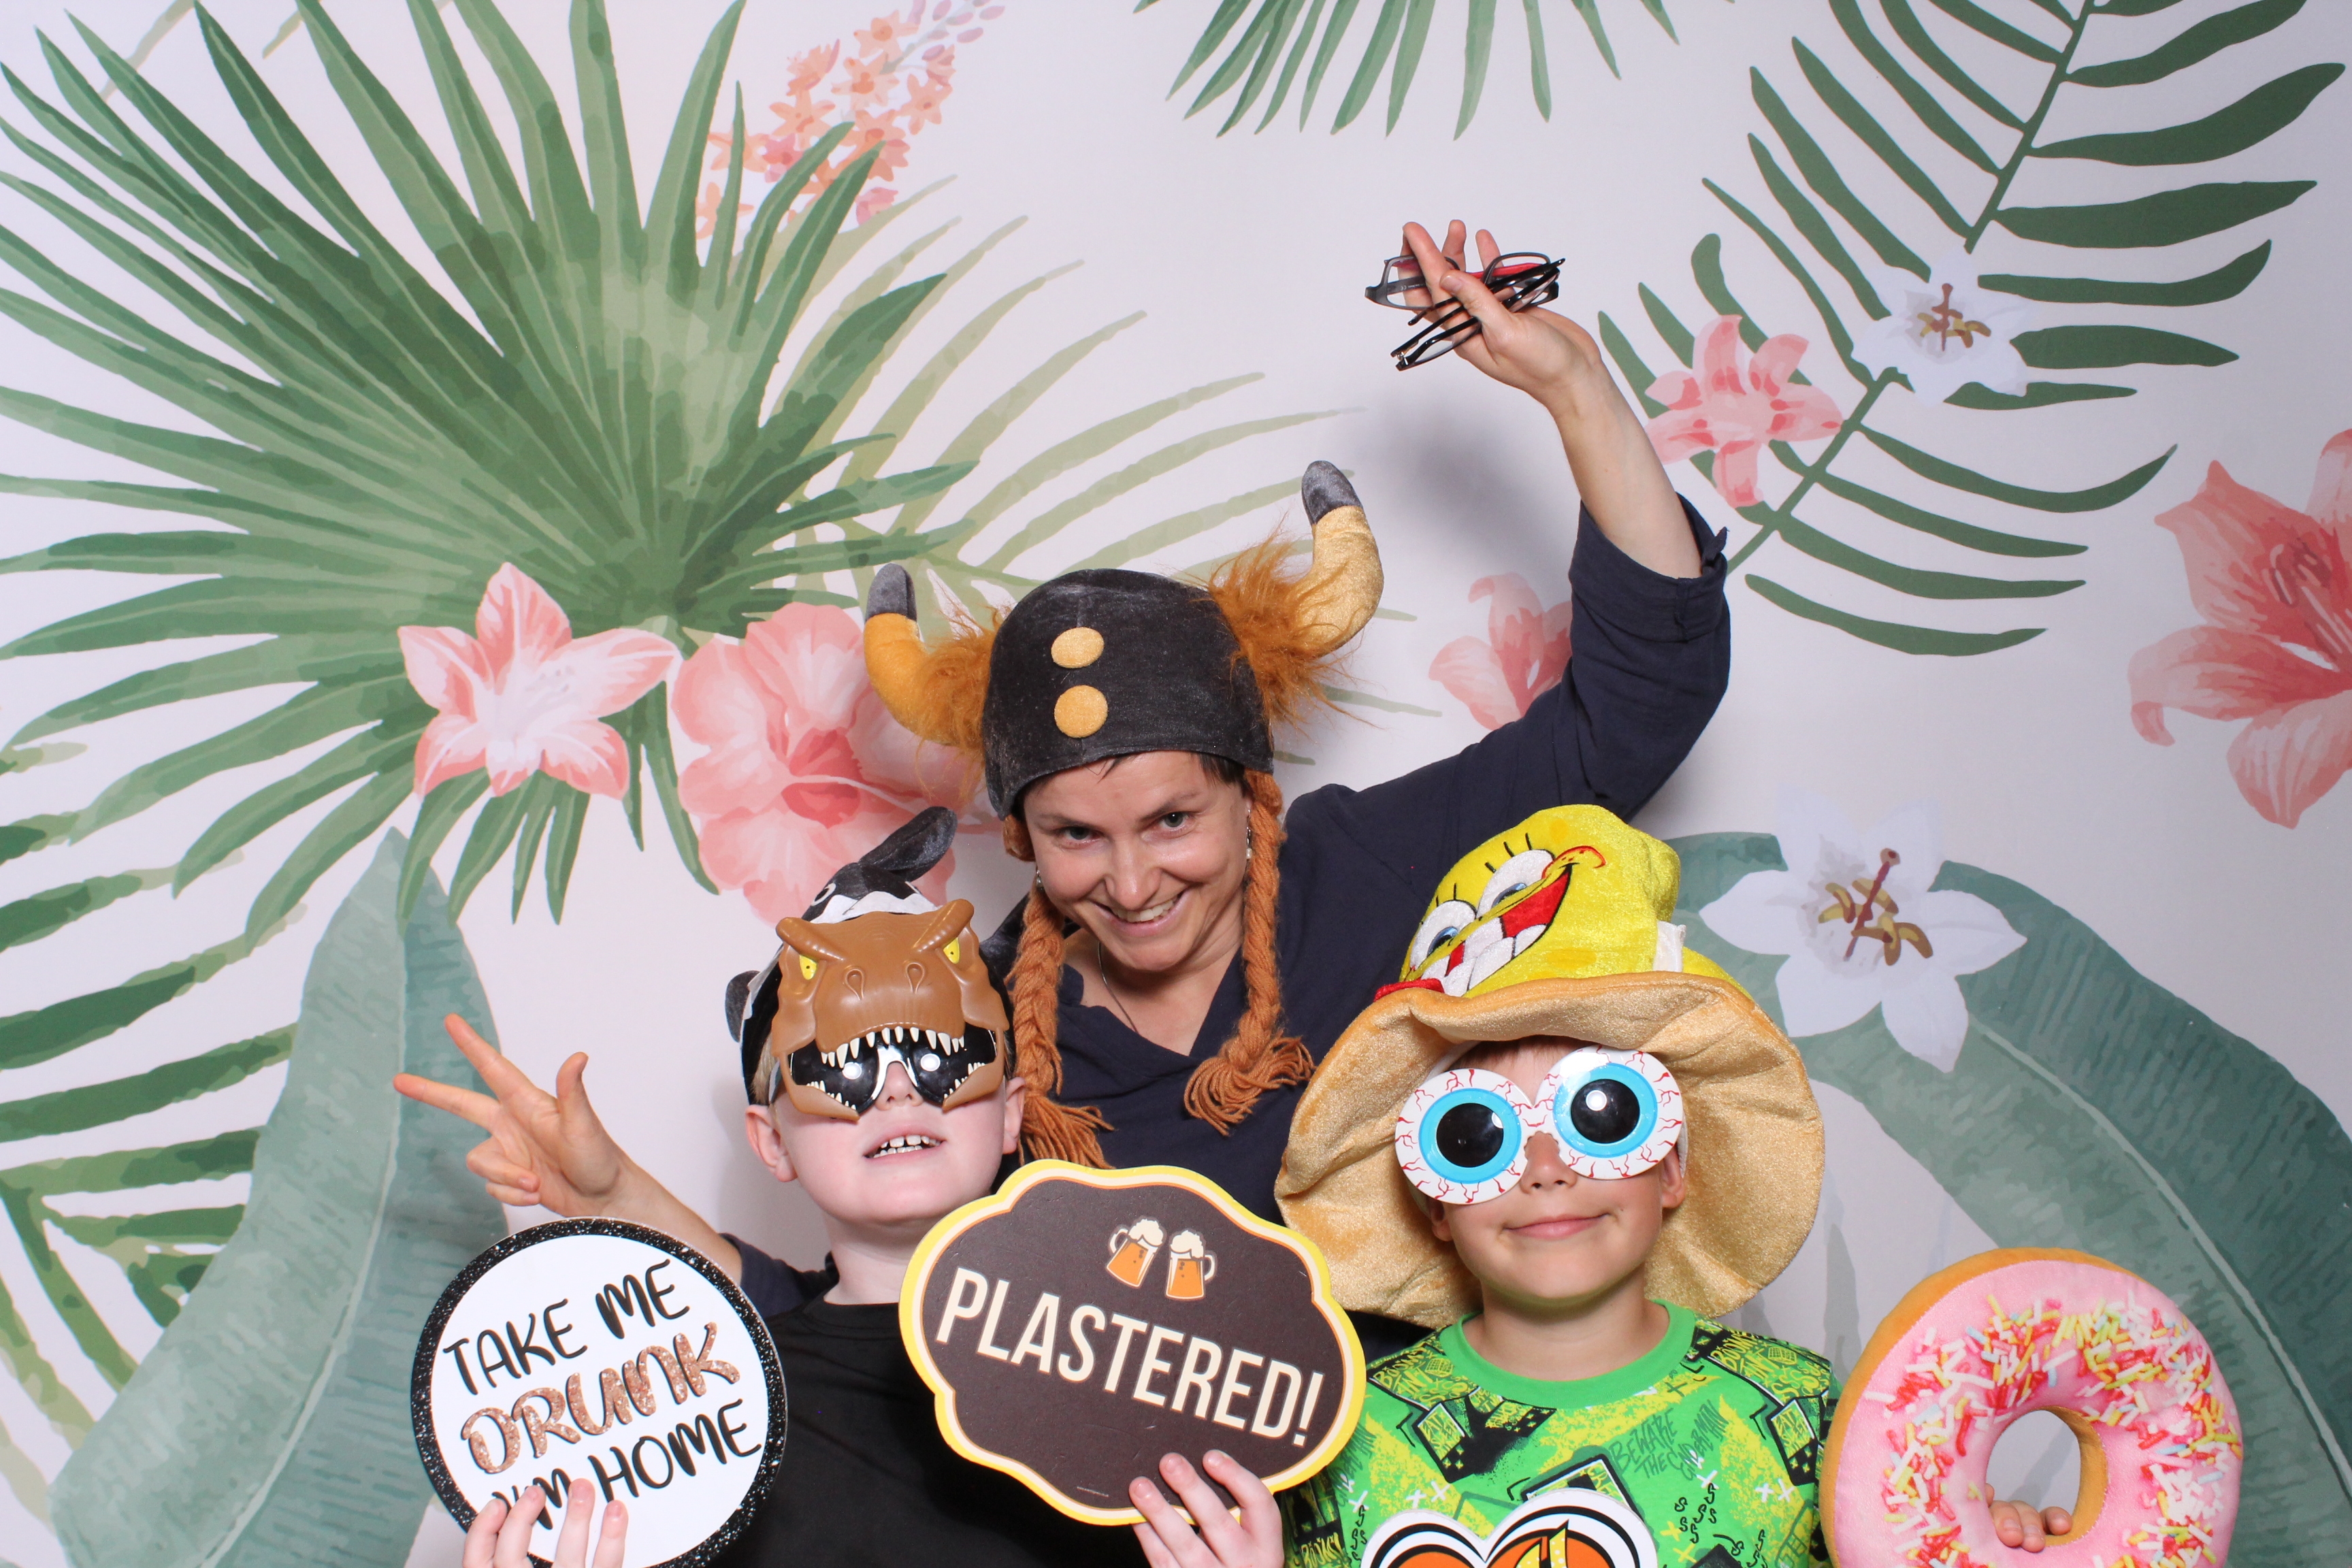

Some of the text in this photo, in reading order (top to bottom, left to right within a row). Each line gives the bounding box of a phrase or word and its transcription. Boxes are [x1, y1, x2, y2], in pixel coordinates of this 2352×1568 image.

[443, 1258, 690, 1395] TAKE ME
[936, 1267, 1324, 1448] PLASTERED!
[461, 1321, 740, 1474] DRUNK
[588, 1399, 762, 1502] HOME
[1608, 1407, 1678, 1475] BEWARE
[1634, 1452, 1668, 1479] THE
